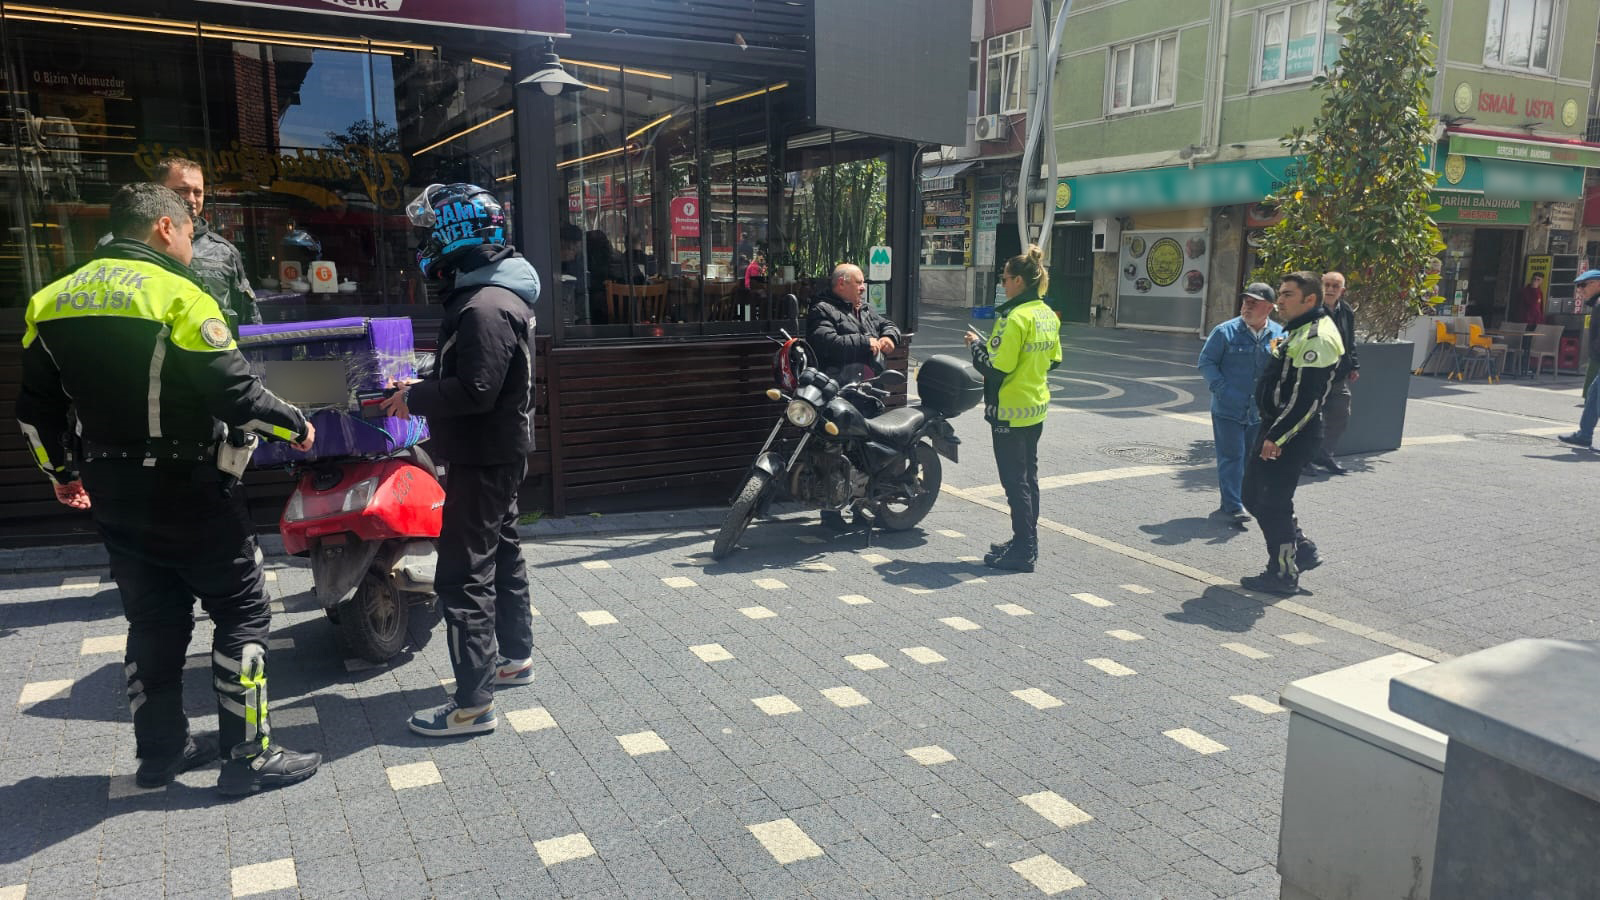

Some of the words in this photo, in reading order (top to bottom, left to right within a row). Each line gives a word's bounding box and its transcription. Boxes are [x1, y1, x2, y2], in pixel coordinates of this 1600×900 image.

[43, 71, 69, 84] Bizim
[71, 73, 125, 88] Yolumuzdur
[1525, 98, 1555, 120] USTA
[1439, 194, 1470, 207] TARİHİ
[1473, 197, 1521, 209] BANDIRMA
[433, 199, 488, 229] GAME
[431, 221, 476, 246] OVER
[65, 265, 151, 291] TRAFİK
[321, 268, 328, 279] 6
[55, 290, 135, 313] POLİSİ
